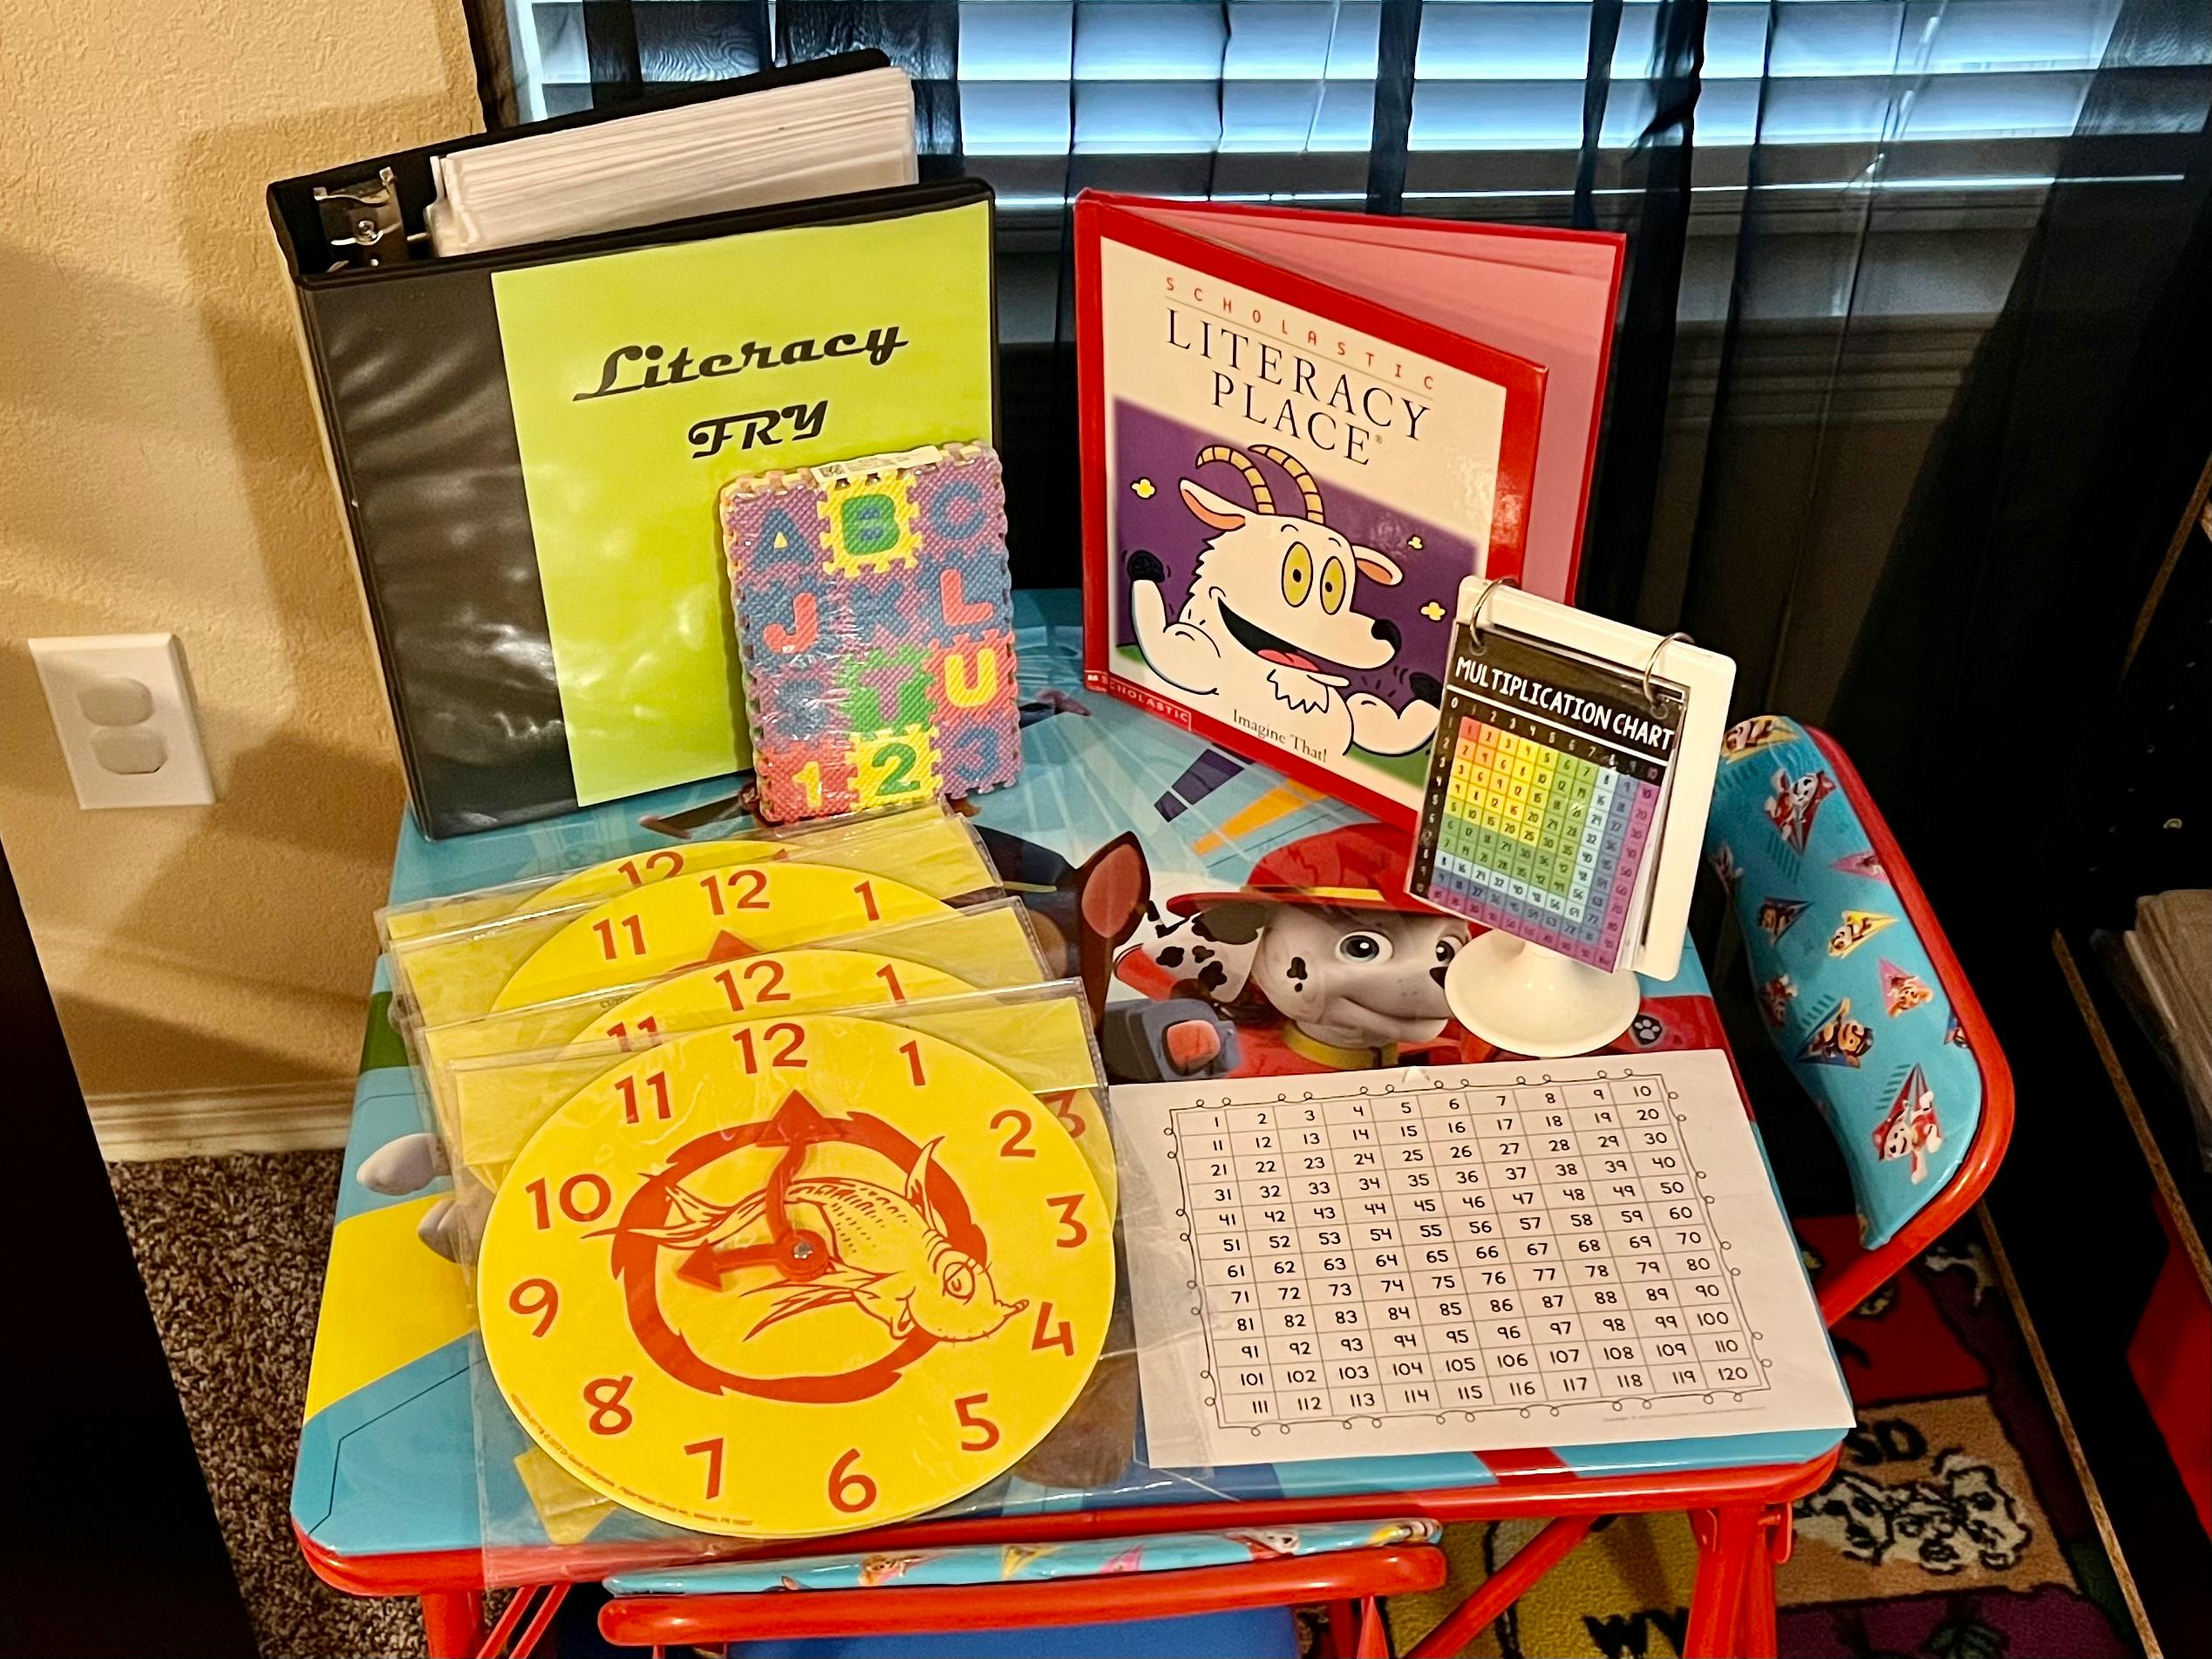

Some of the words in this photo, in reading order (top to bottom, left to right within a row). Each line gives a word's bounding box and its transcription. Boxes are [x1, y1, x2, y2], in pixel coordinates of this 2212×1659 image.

[1167, 277, 1434, 391] SCHOLASTIC
[573, 326, 909, 401] Literacy
[1167, 307, 1430, 441] LITERACY
[689, 400, 828, 459] FRY
[751, 507, 814, 573] A
[841, 494, 900, 555] B
[929, 482, 986, 540] C
[764, 592, 818, 653] J
[851, 580, 912, 640] K
[940, 568, 994, 627] L
[777, 679, 827, 736] S
[861, 665, 915, 721] T
[945, 648, 997, 707] U
[1455, 656, 1612, 731] MULTIPLICATION
[1613, 713, 1675, 751] CHART
[1233, 709, 1287, 738] Imagine
[1290, 734, 1327, 763] That!
[792, 761, 822, 808] 1
[872, 743, 921, 797] 2
[956, 725, 998, 780] 3
[618, 851, 684, 886] 12
[698, 869, 771, 916] 12
[853, 881, 880, 921] 1
[591, 914, 647, 960] 11
[711, 959, 792, 1013] 12
[874, 963, 908, 1005] 1
[730, 1022, 809, 1075] 12
[897, 1040, 926, 1087] 1
[612, 1071, 671, 1125] 11
[1215, 1117, 1219, 1128] 1
[1257, 1112, 1267, 1125] 2
[1303, 1110, 1316, 1122] 3
[1352, 1105, 1365, 1117] 4
[1400, 1101, 1412, 1114] 5
[1448, 1098, 1460, 1111] 6
[1495, 1095, 1507, 1106] 7
[1544, 1092, 1556, 1105] 8
[1593, 1089, 1605, 1100] 9
[1633, 1085, 1652, 1098] 10
[988, 1109, 1036, 1159] 2
[1210, 1163, 1228, 1177] 21
[1255, 1160, 1276, 1173] 22
[1303, 1156, 1325, 1170] 23
[1353, 1152, 1375, 1166] 24
[1402, 1149, 1424, 1162] 25
[1449, 1145, 1473, 1159] 26
[1499, 1142, 1520, 1156] 27
[1548, 1139, 1570, 1152] 28
[1596, 1135, 1620, 1148] 29
[1644, 1132, 1668, 1146] 30
[1213, 1139, 1223, 1152] 11
[1255, 1136, 1272, 1148] 12
[1303, 1132, 1320, 1145] 13
[1352, 1128, 1370, 1141] 14
[1400, 1125, 1418, 1138] 15
[1447, 1121, 1467, 1133] 16
[1496, 1118, 1513, 1131] 17
[1545, 1115, 1563, 1127] 18
[1594, 1112, 1612, 1124] 19
[1636, 1108, 1660, 1121] 20
[523, 1173, 613, 1231] 10
[1214, 1188, 1232, 1202] 31
[1259, 1185, 1282, 1199] 32
[1308, 1181, 1331, 1195] 33
[1358, 1177, 1380, 1191] 34
[1407, 1173, 1430, 1187] 35
[1455, 1170, 1479, 1185] 36
[1505, 1166, 1527, 1180] 37
[1555, 1163, 1578, 1177] 38
[1604, 1159, 1628, 1173] 39
[1651, 1156, 1676, 1169] 40
[1219, 1213, 1236, 1227] 41
[1264, 1210, 1286, 1223] 42
[1313, 1207, 1336, 1220] 43
[1364, 1202, 1386, 1215] 44
[1413, 1199, 1436, 1212] 45
[1461, 1195, 1486, 1208] 46
[1512, 1192, 1534, 1205] 47
[1562, 1188, 1586, 1201] 48
[1612, 1185, 1636, 1198] 49
[1659, 1181, 1685, 1194] 50
[1045, 1193, 1088, 1249] 3
[1222, 1238, 1241, 1252] 51
[1269, 1235, 1291, 1249] 52
[1318, 1231, 1341, 1246] 53
[1370, 1227, 1392, 1242] 54
[1419, 1223, 1443, 1238] 55
[1468, 1220, 1493, 1234] 56
[1519, 1216, 1541, 1231] 57
[1570, 1214, 1594, 1227] 58
[1620, 1209, 1644, 1224] 59
[1669, 1206, 1693, 1220] 60
[1227, 1264, 1245, 1278] 61
[1274, 1261, 1296, 1275] 62
[1324, 1257, 1347, 1271] 63
[1375, 1254, 1399, 1268] 64
[1426, 1249, 1449, 1264] 65
[1475, 1245, 1499, 1260] 66
[1527, 1242, 1548, 1256] 67
[1578, 1239, 1602, 1253] 68
[1629, 1235, 1652, 1249] 69
[1676, 1231, 1702, 1245] 70
[1230, 1290, 1249, 1304] 71
[1277, 1287, 1301, 1301] 72
[1328, 1282, 1352, 1300] 73
[1380, 1279, 1405, 1294] 74
[1431, 1275, 1456, 1289] 75
[1480, 1271, 1507, 1286] 76
[1532, 1268, 1556, 1282] 77
[1584, 1264, 1610, 1278] 78
[1636, 1261, 1661, 1275] 79
[1686, 1257, 1711, 1271] 80
[507, 1278, 559, 1338] 9
[1030, 1301, 1075, 1357] 4
[1236, 1317, 1255, 1332] 81
[1283, 1313, 1307, 1329] 82
[1334, 1309, 1358, 1324] 83
[1387, 1306, 1411, 1321] 84
[1439, 1302, 1462, 1316] 85
[1489, 1298, 1514, 1313] 86
[1542, 1294, 1563, 1309] 87
[1594, 1290, 1618, 1305] 88
[1645, 1288, 1670, 1302] 89
[1695, 1284, 1719, 1298] 90
[1241, 1345, 1259, 1359] 91
[1289, 1341, 1311, 1356] 92
[1340, 1337, 1364, 1352] 93
[1393, 1333, 1417, 1348] 94
[1446, 1329, 1469, 1344] 95
[1496, 1325, 1521, 1340] 96
[1549, 1321, 1571, 1336] 97
[1603, 1317, 1626, 1332] 98
[1655, 1316, 1678, 1329] 99
[1697, 1311, 1729, 1327] 100
[581, 1374, 634, 1436] 8
[952, 1392, 1001, 1452] 5
[681, 1437, 725, 1500] 7
[826, 1447, 878, 1513] 6
